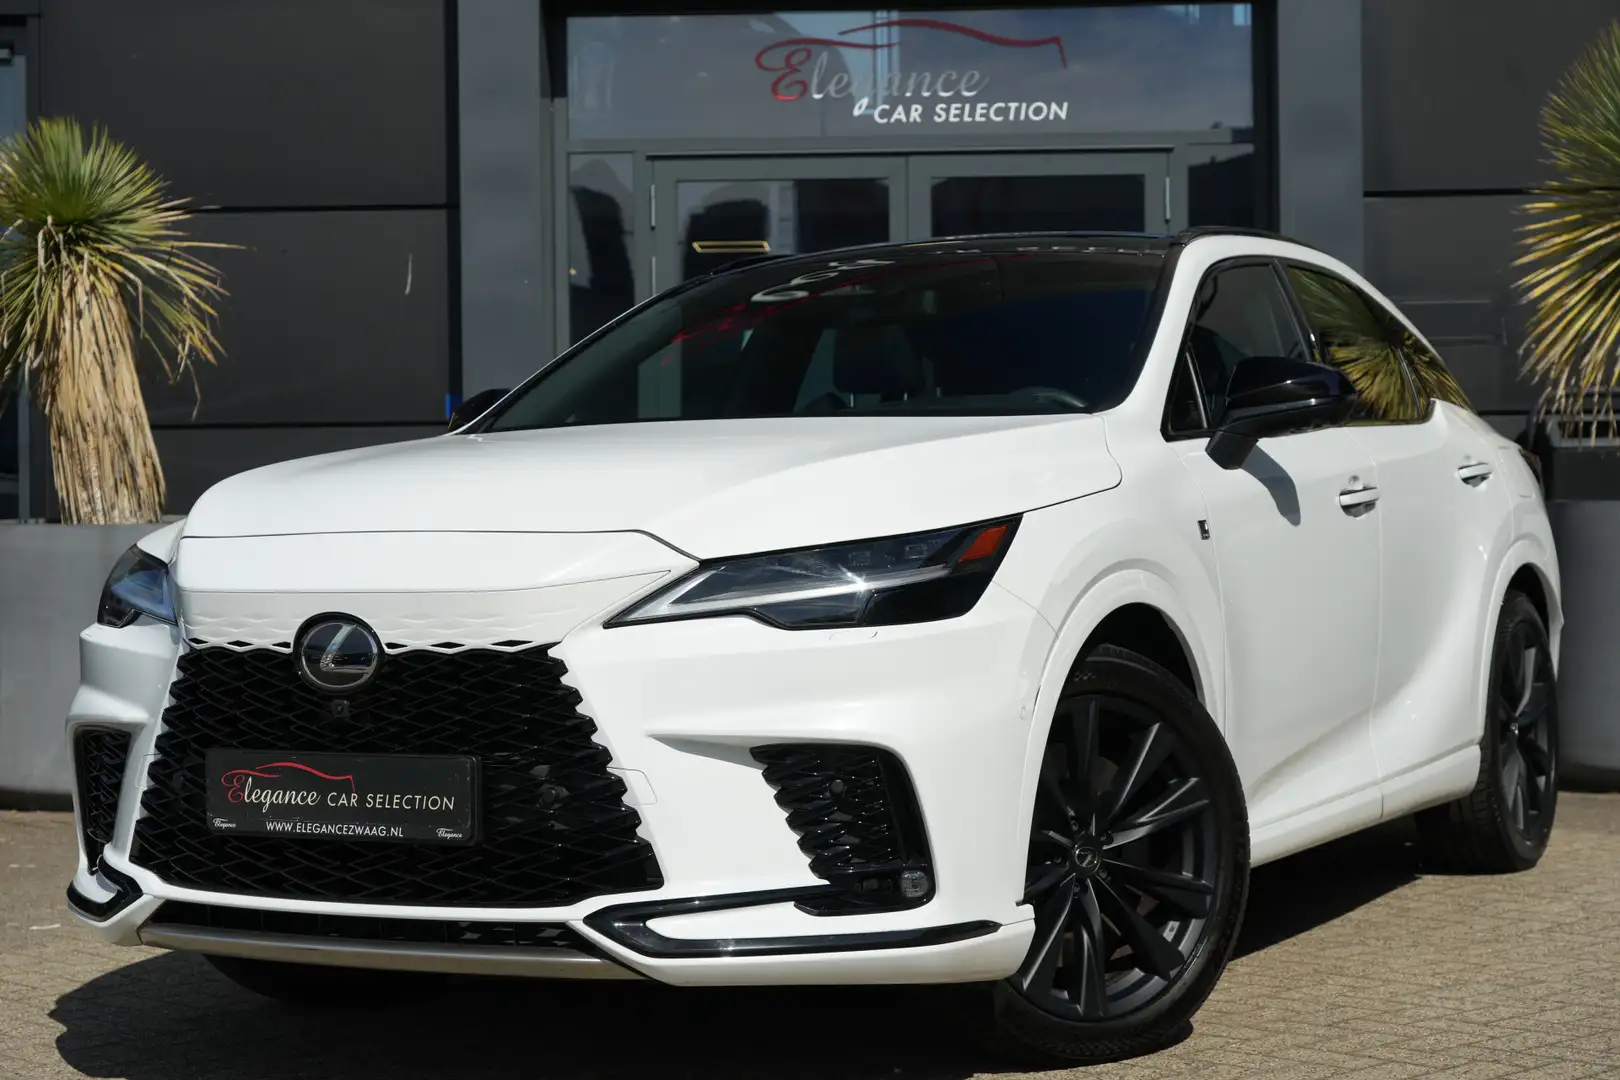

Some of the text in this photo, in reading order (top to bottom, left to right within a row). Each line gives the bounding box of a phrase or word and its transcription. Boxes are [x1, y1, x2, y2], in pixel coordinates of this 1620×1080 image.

[873, 102, 1068, 123] CAR SELECTION
[221, 769, 455, 813] Elegance CAR SELECTION
[265, 821, 404, 837] WWW.ELEGANCEZWAAG.NL
